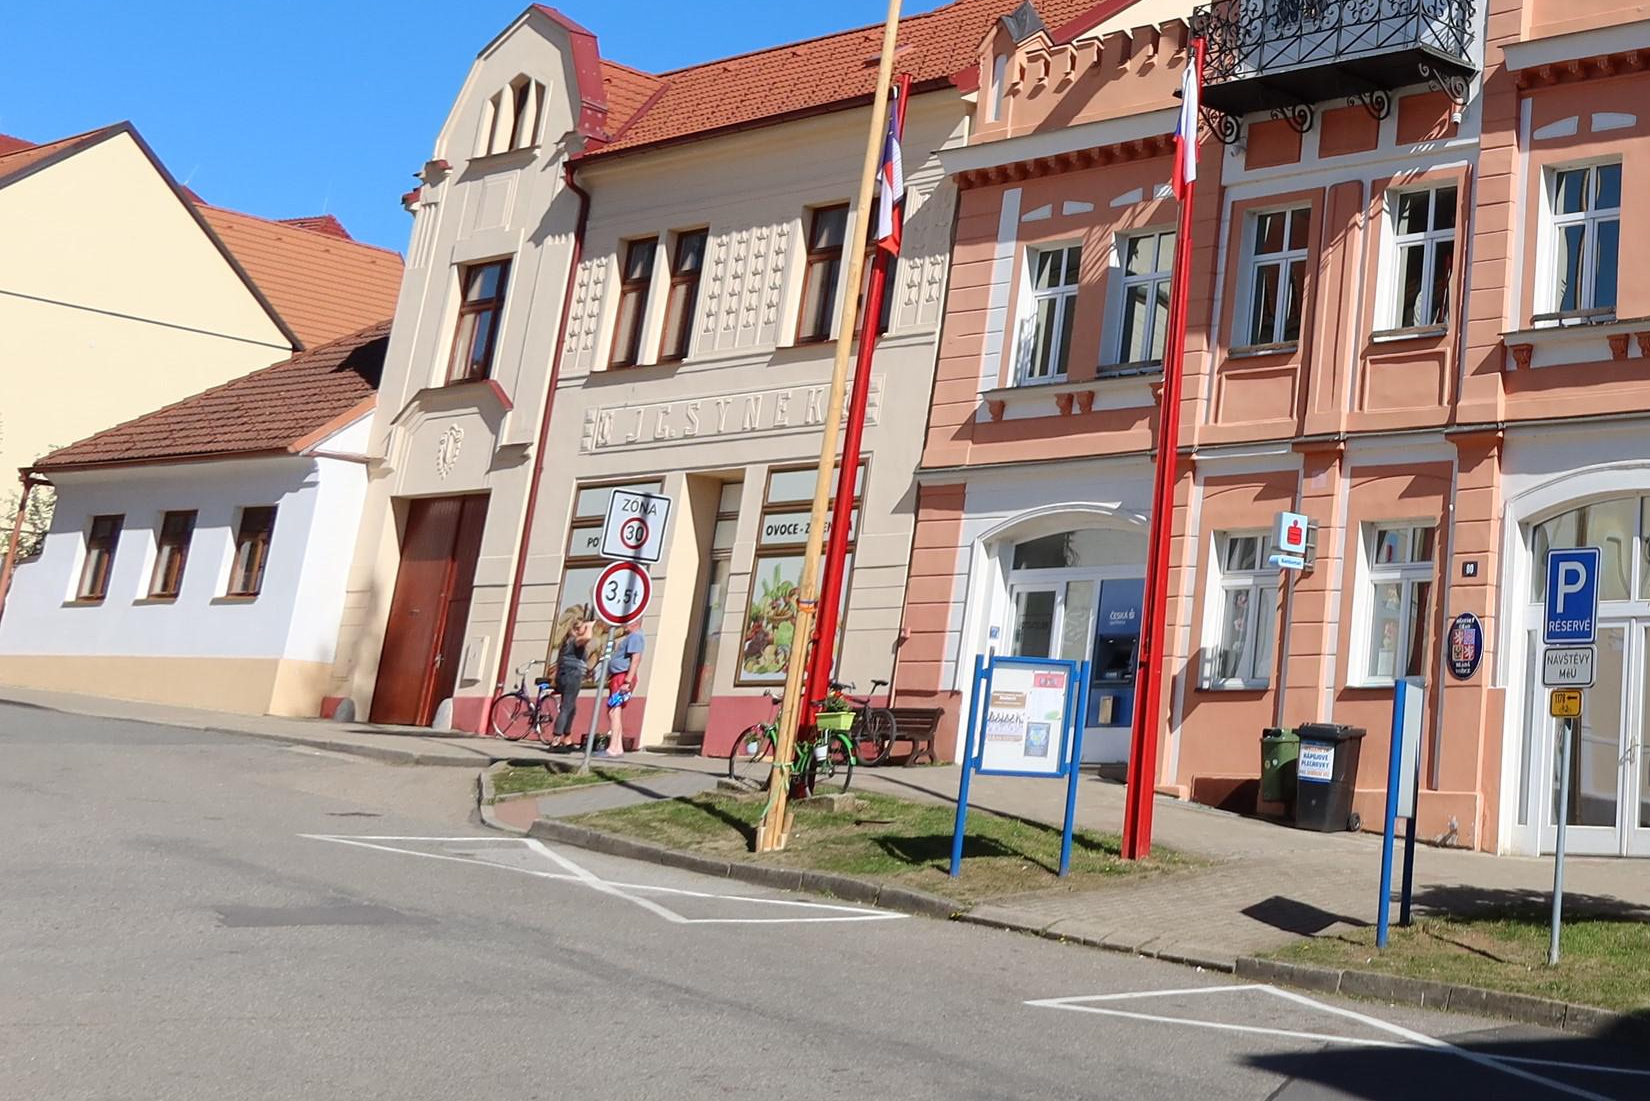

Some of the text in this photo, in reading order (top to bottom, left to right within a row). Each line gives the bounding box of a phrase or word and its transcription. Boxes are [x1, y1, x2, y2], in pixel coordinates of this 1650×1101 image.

[683, 387, 825, 438] SYNEK
[621, 498, 658, 517] ZÓNA
[625, 524, 645, 542] 30
[1556, 560, 1587, 614] P
[1548, 618, 1591, 632] RÉSERVÉ
[1547, 653, 1591, 666] NÁVŠTĚVY
